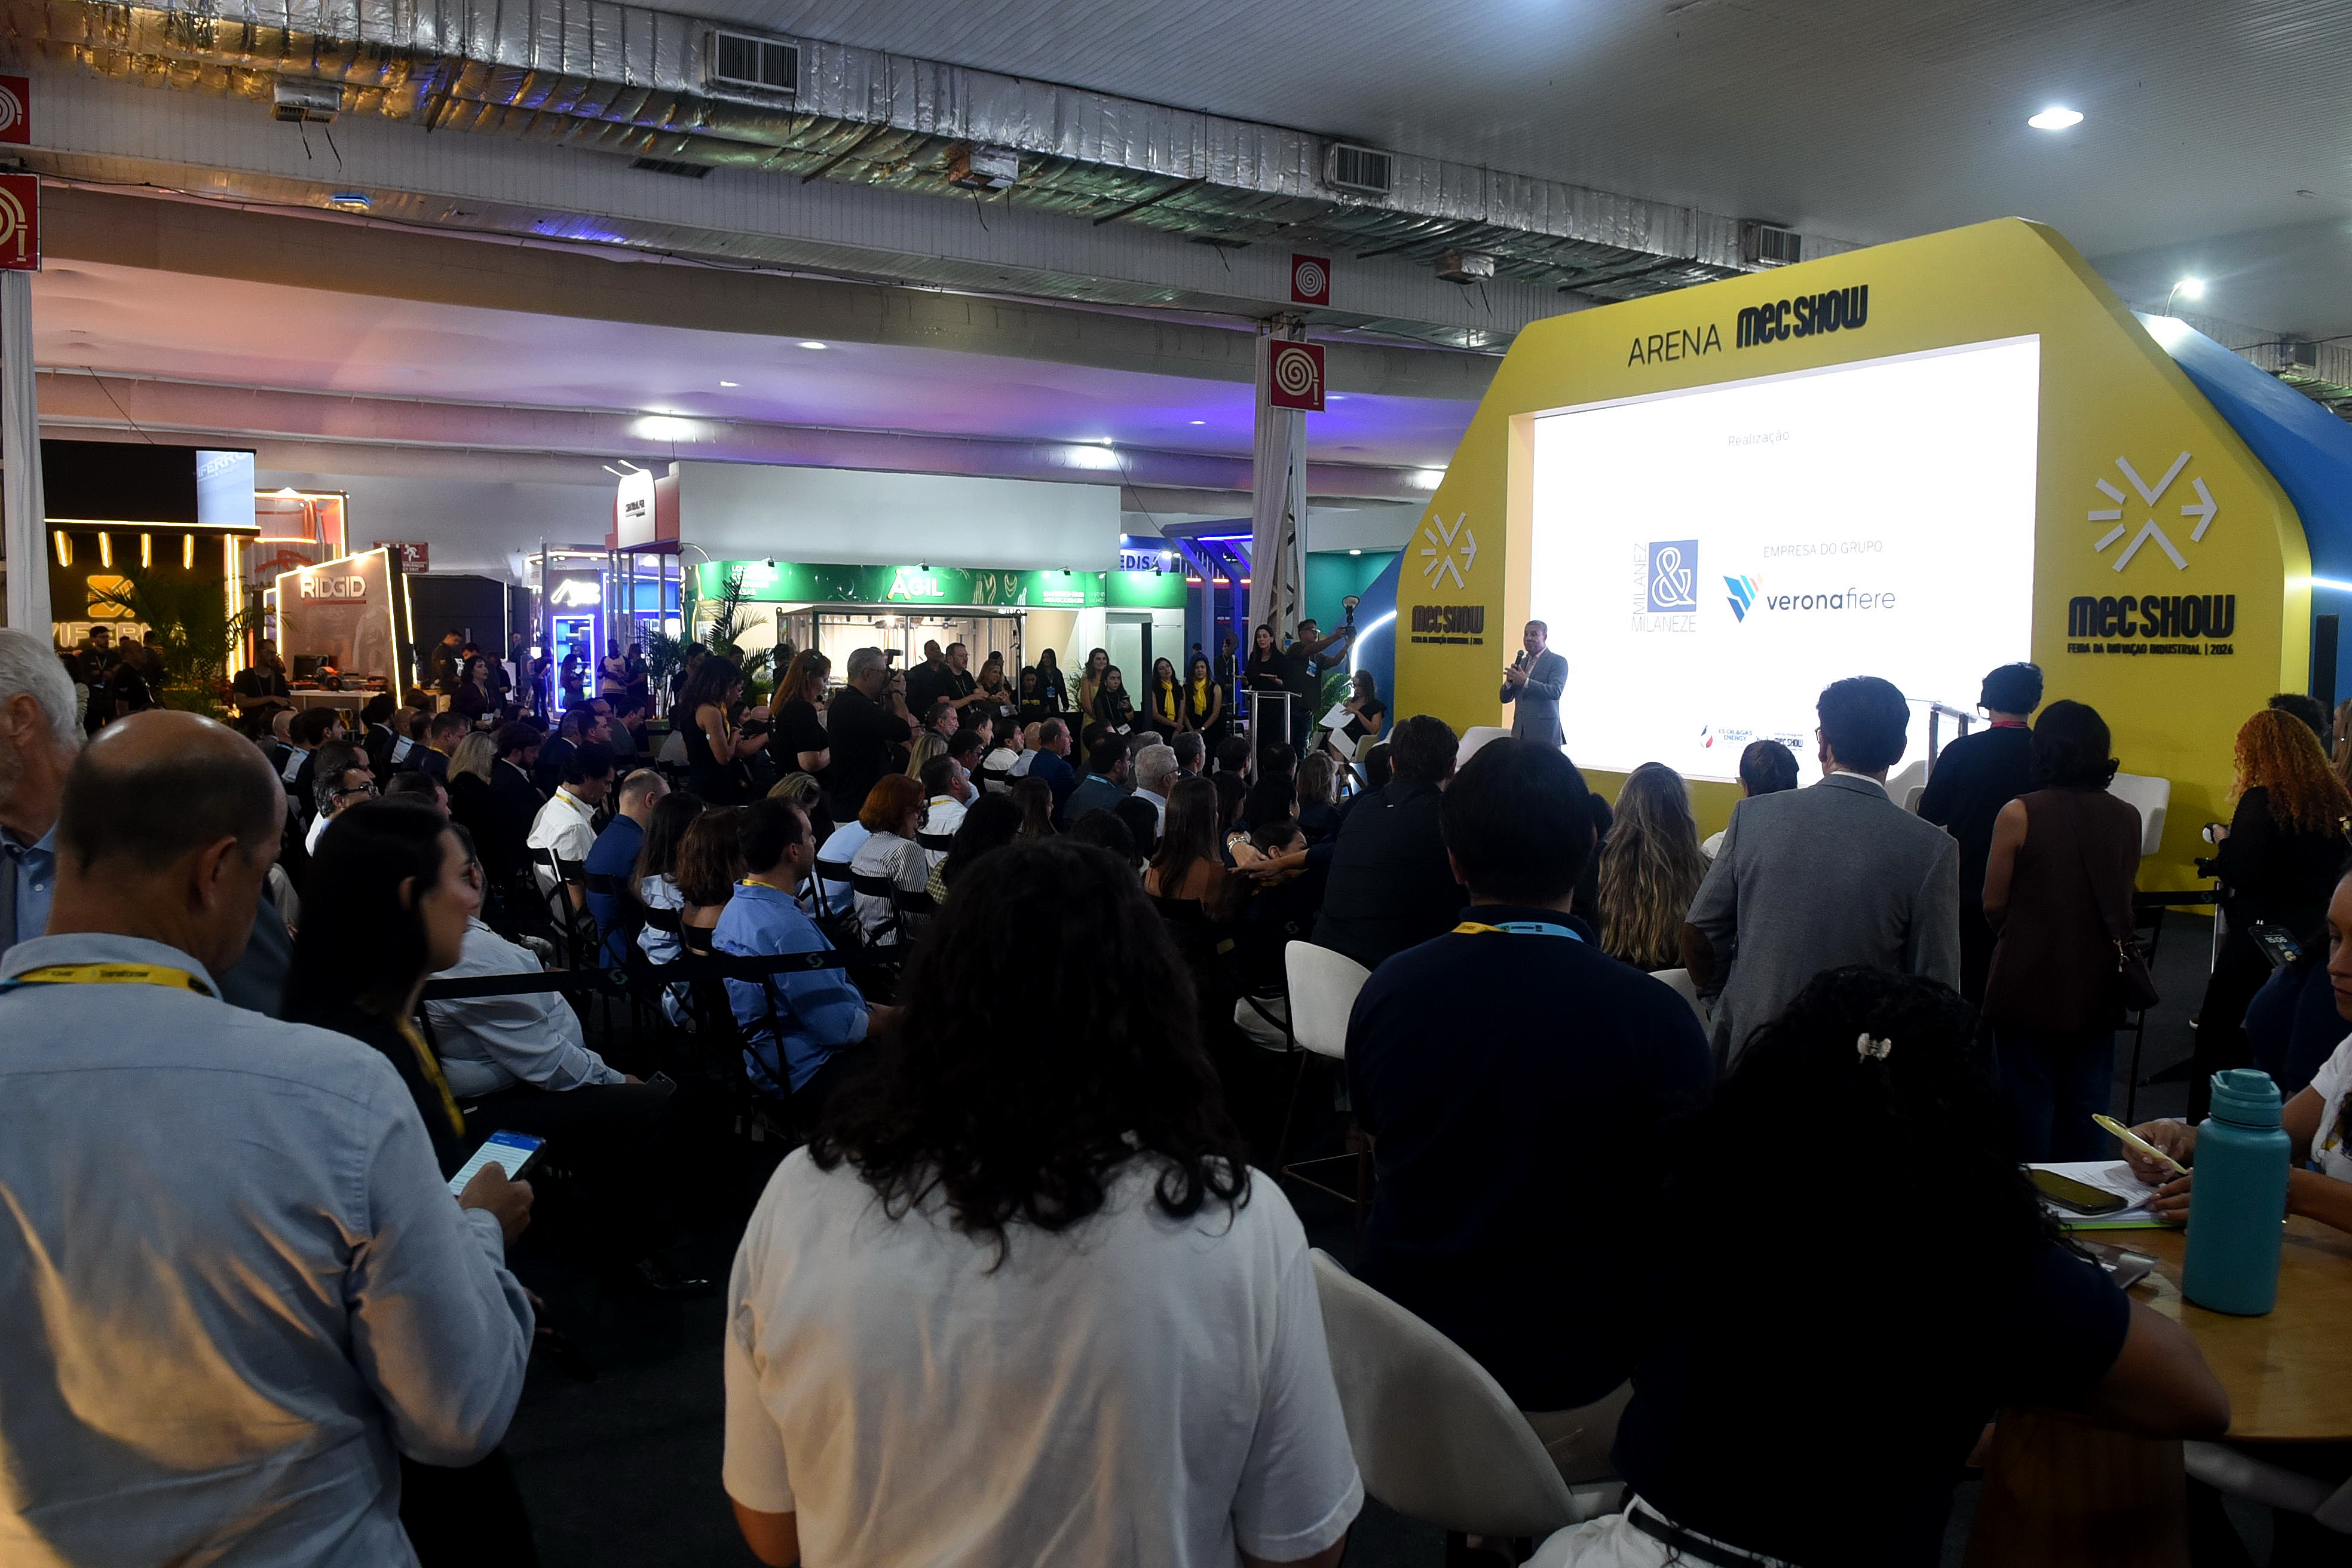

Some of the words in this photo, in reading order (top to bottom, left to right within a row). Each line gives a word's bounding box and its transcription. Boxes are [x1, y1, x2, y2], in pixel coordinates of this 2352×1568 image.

[1628, 323, 1722, 368] ARENA
[1728, 430, 1790, 447] Realização
[1763, 544, 1817, 558] EMPRESA
[1820, 543, 1837, 555] DO
[1840, 540, 1883, 555] GRUPO
[300, 575, 366, 598] RIDGID
[1633, 541, 1647, 615] MILANEZ
[1766, 587, 1895, 610] veronafiere
[1632, 615, 1697, 632] MILANEZE
[2093, 644, 2105, 653] DA
[2149, 644, 2202, 655] INDUSTRIAL
[2210, 644, 2234, 654] 2026
